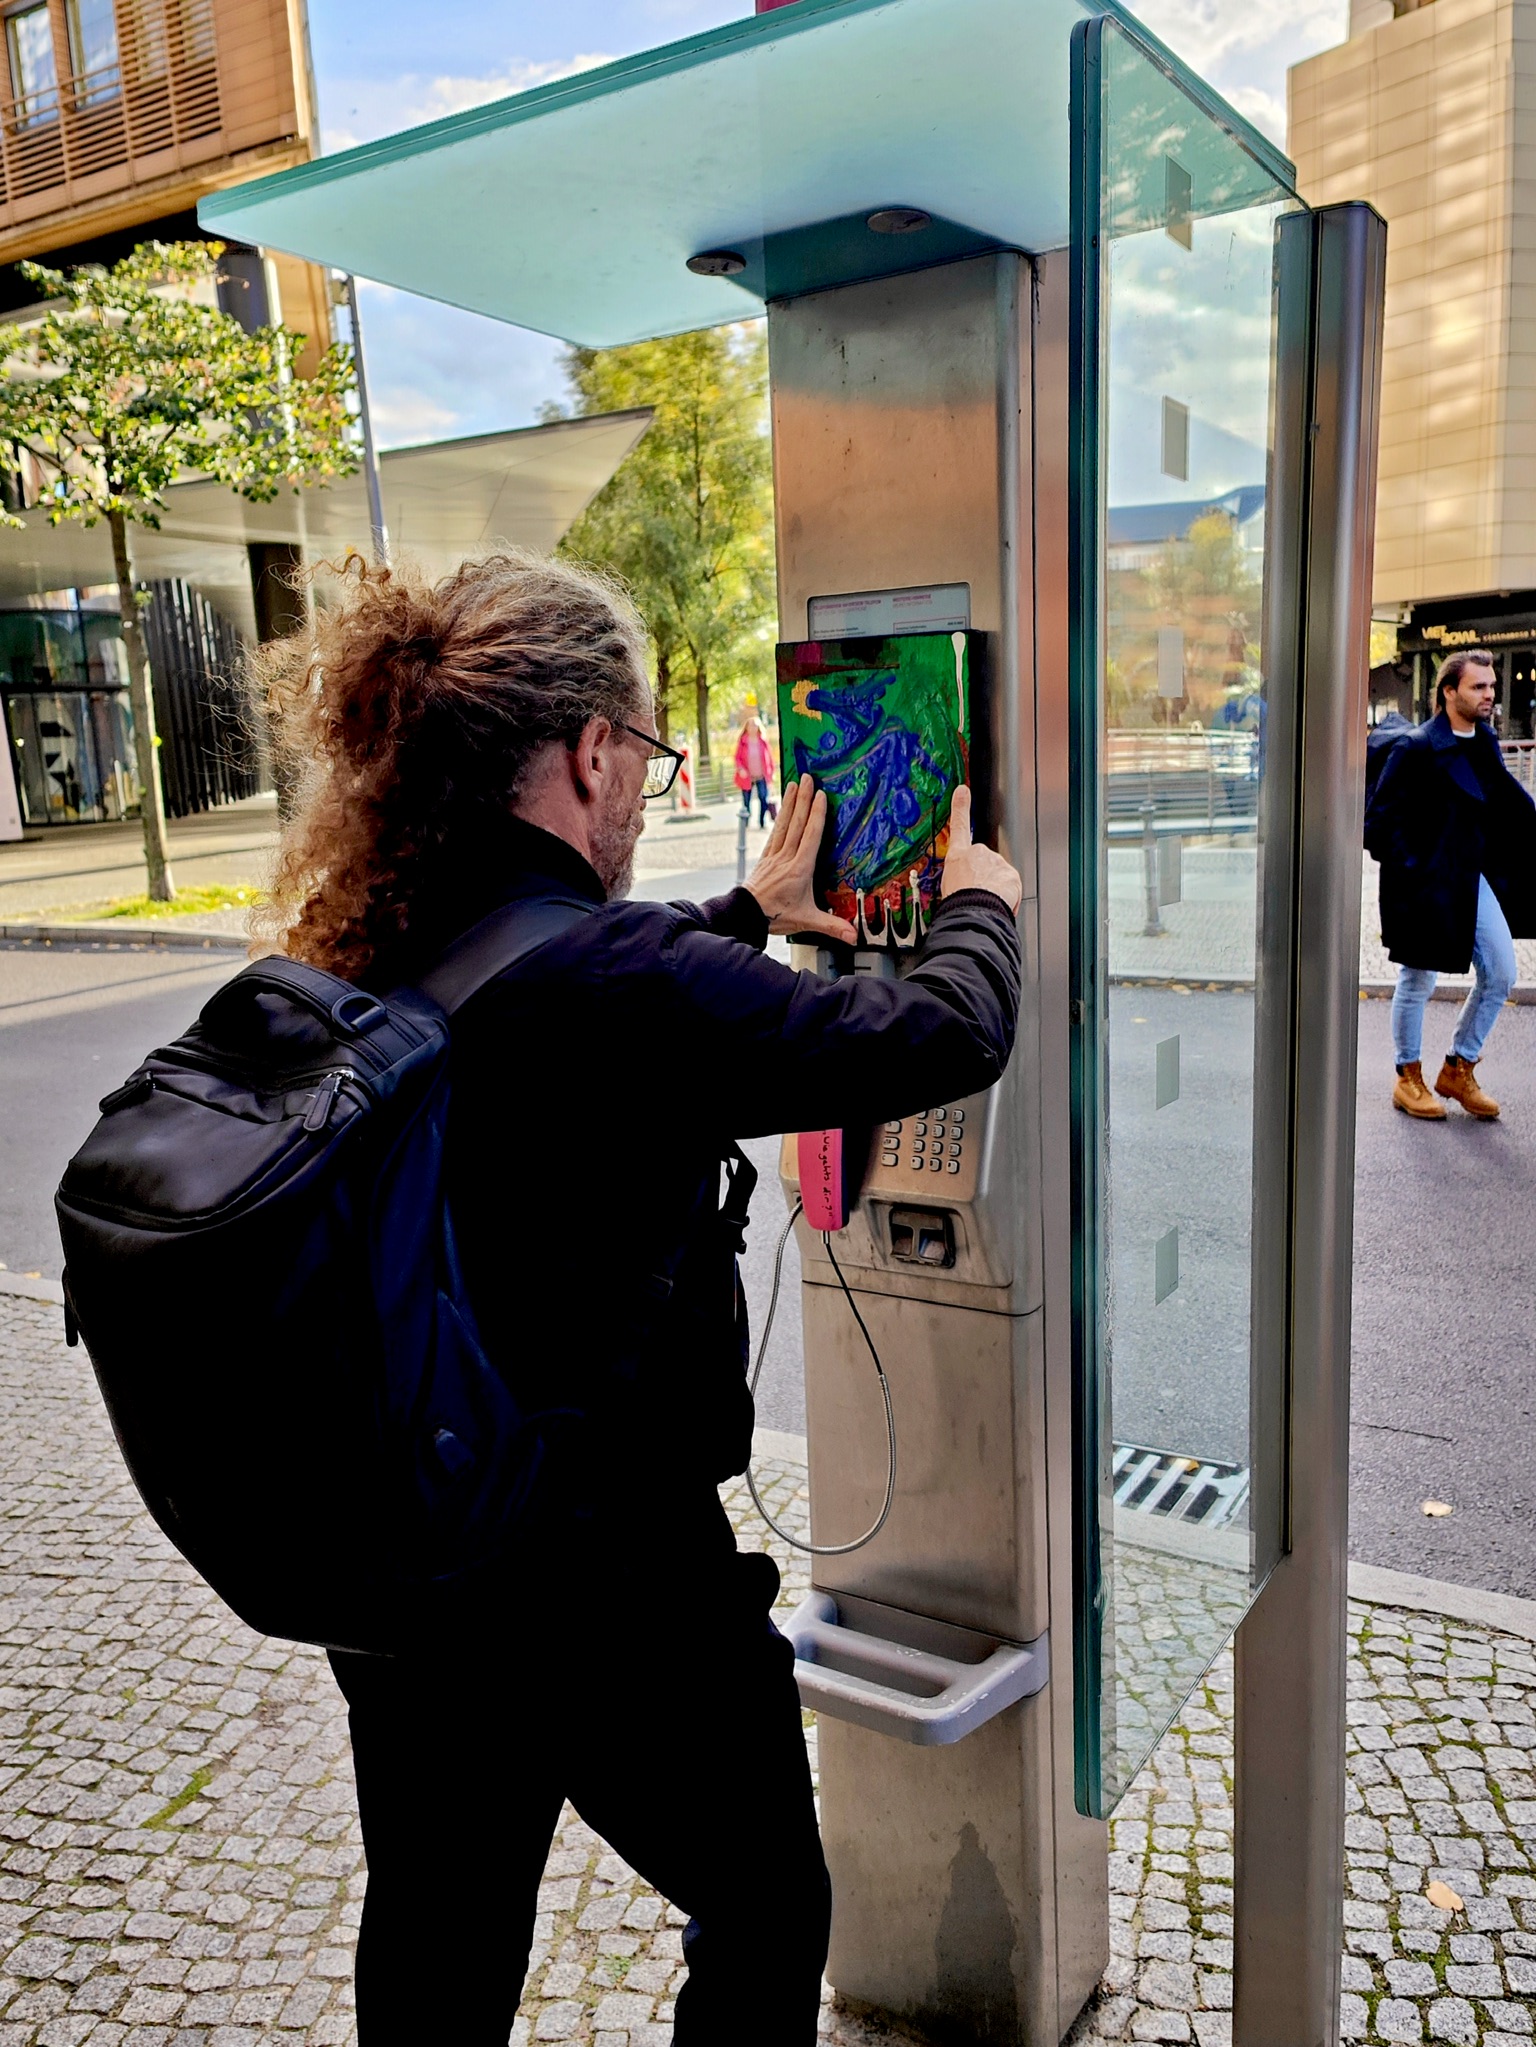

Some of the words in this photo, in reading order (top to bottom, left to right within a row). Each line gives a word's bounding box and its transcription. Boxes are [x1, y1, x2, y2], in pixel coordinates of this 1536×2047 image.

[1421, 624, 1447, 641] VIET
[1440, 629, 1481, 647] BOWL
[818, 1153, 832, 1182] gehts
